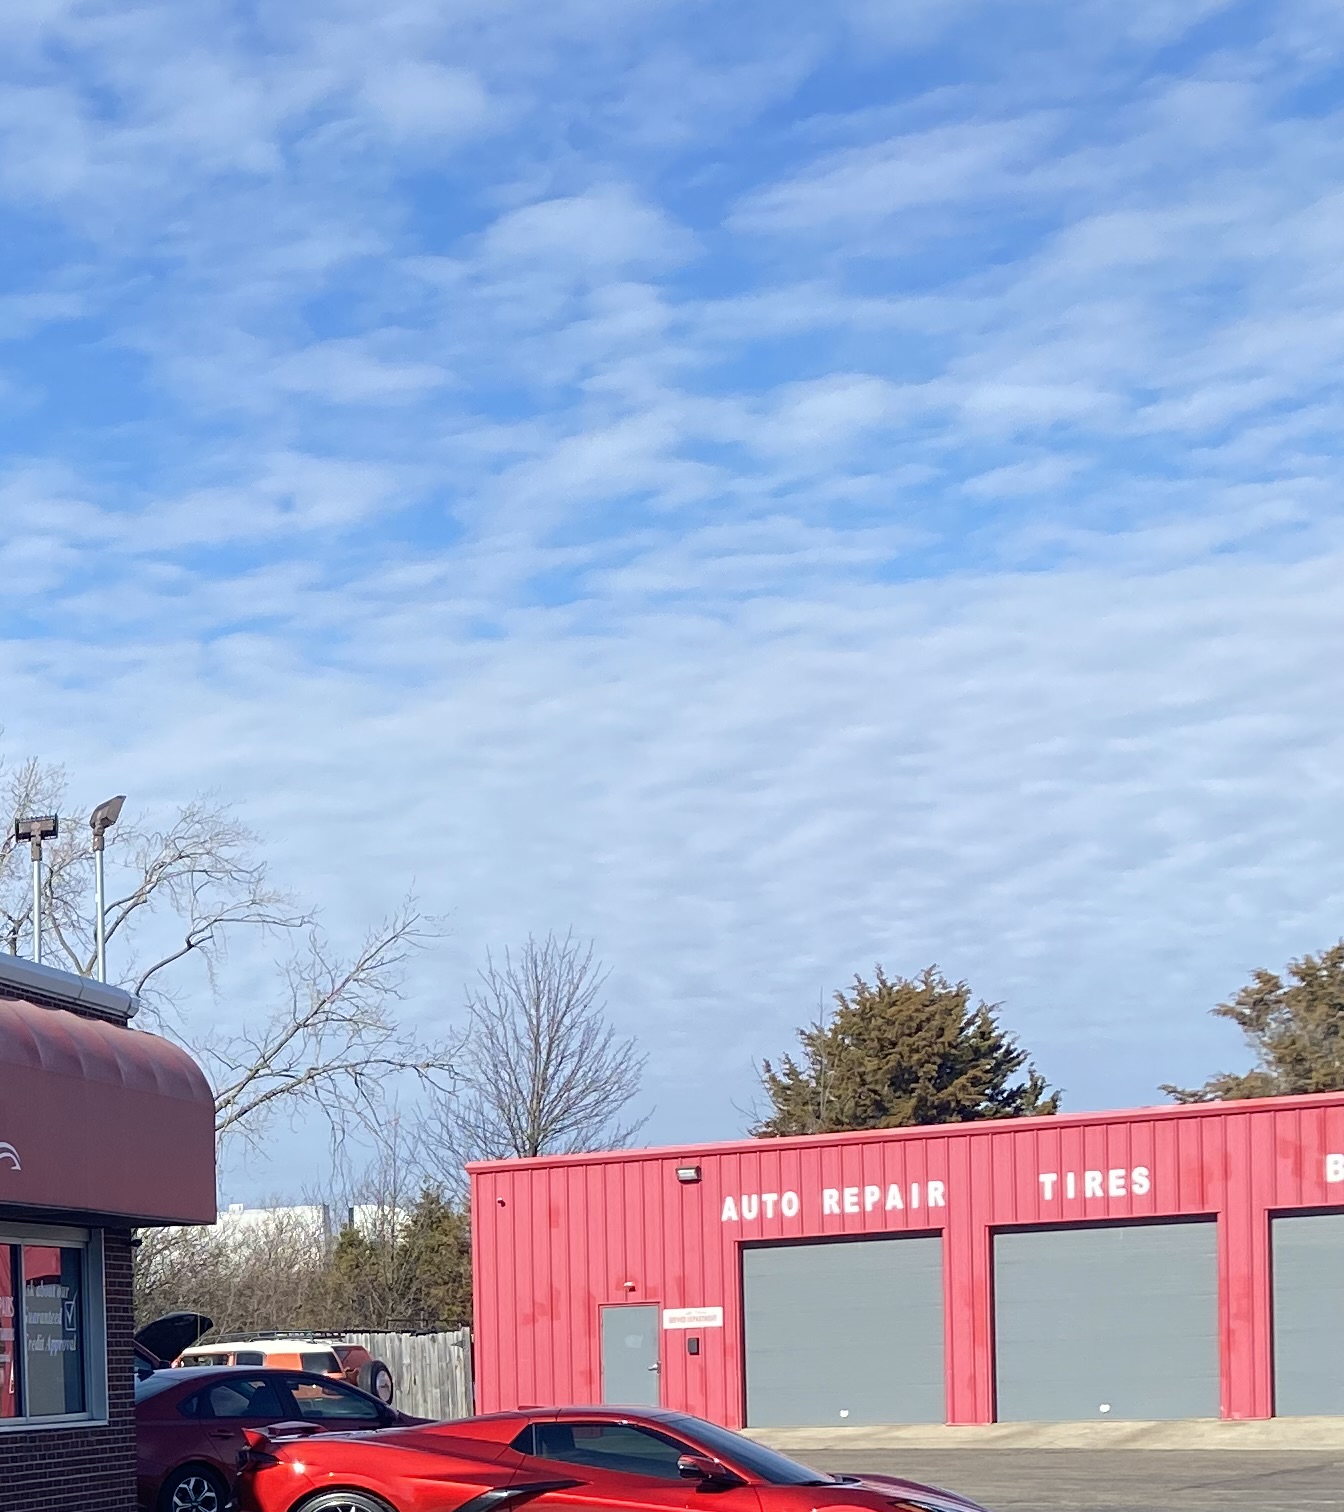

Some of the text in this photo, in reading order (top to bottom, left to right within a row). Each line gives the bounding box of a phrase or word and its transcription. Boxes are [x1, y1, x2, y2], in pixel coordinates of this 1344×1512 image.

[721, 1180, 946, 1222] AUTO REPAIR
[1038, 1166, 1151, 1201] TIRES
